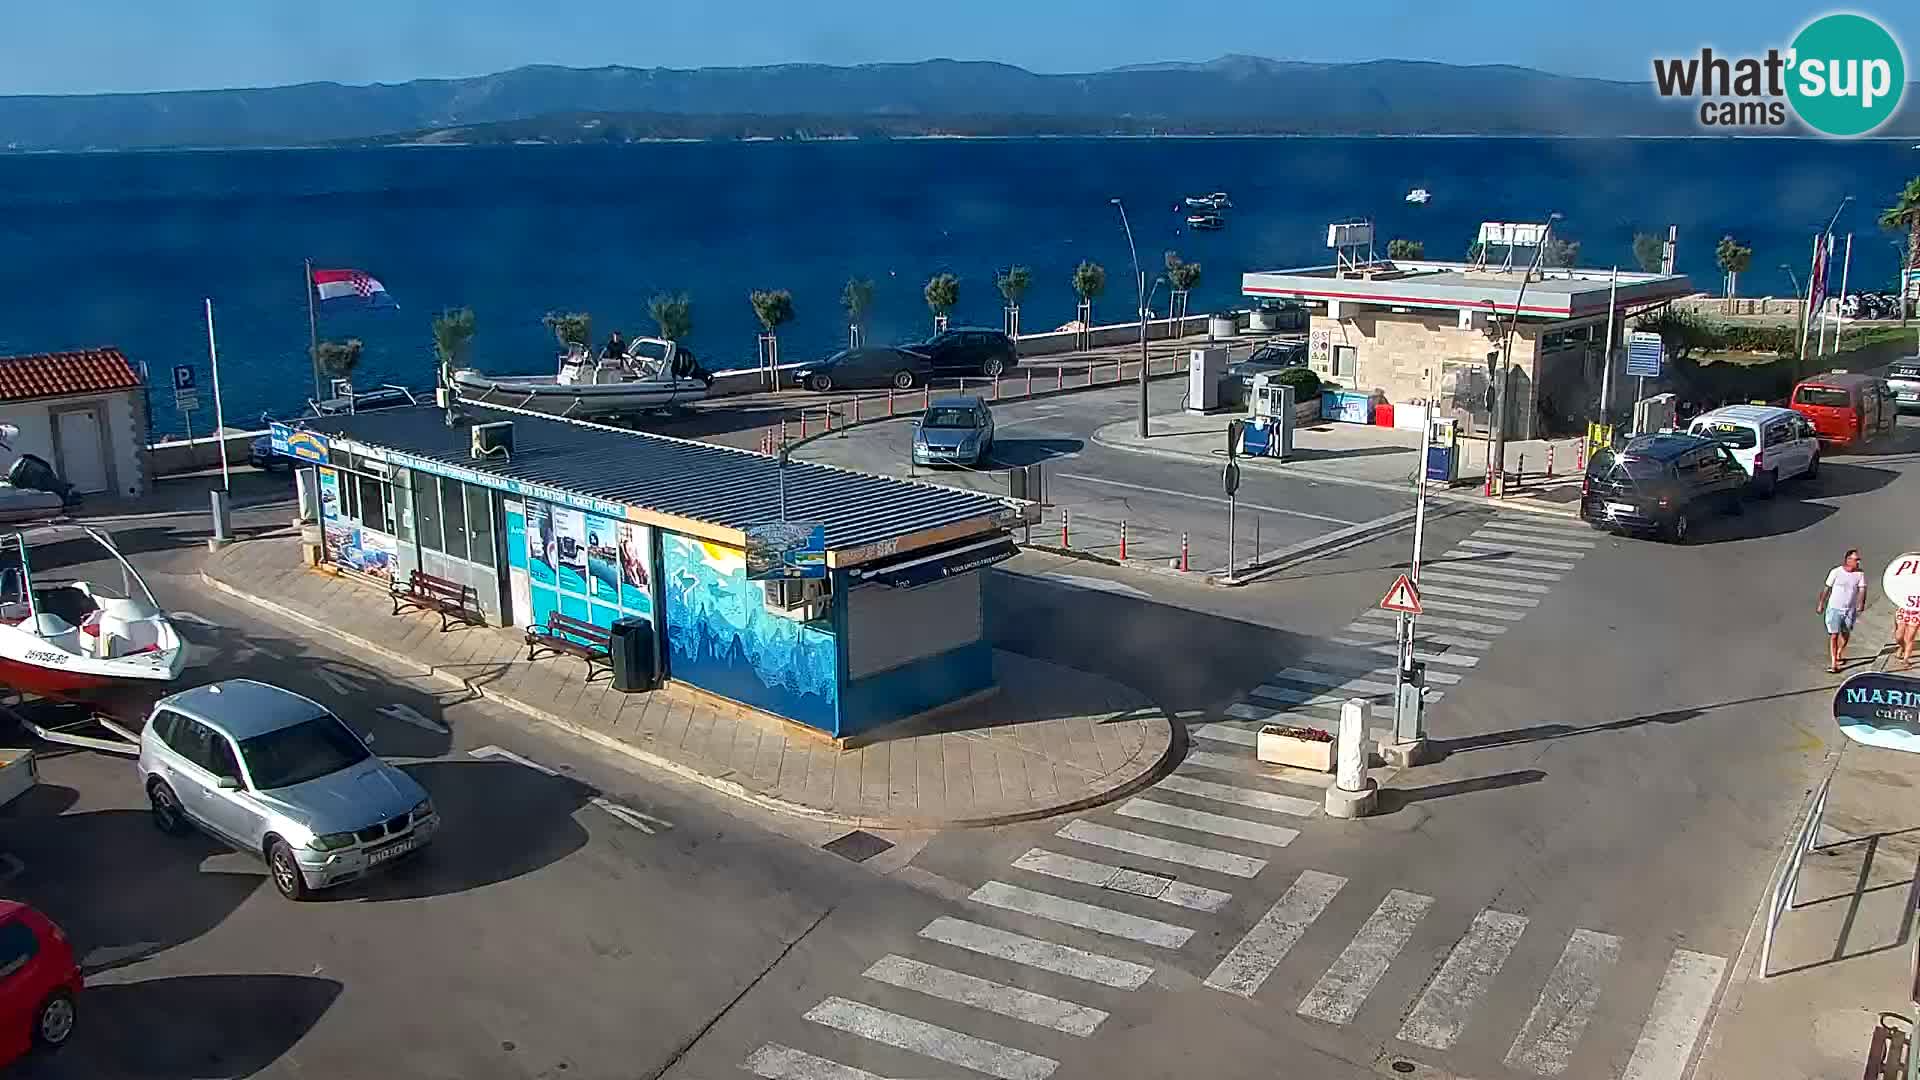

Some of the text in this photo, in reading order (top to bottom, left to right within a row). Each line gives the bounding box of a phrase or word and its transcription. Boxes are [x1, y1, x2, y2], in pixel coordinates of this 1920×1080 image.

[178, 368, 190, 386] P
[1716, 423, 1735, 432] TAXI
[533, 488, 566, 502] STATION
[571, 496, 594, 509] TICKET
[595, 500, 622, 514] OFFICE
[1875, 707, 1913, 722] caffe
